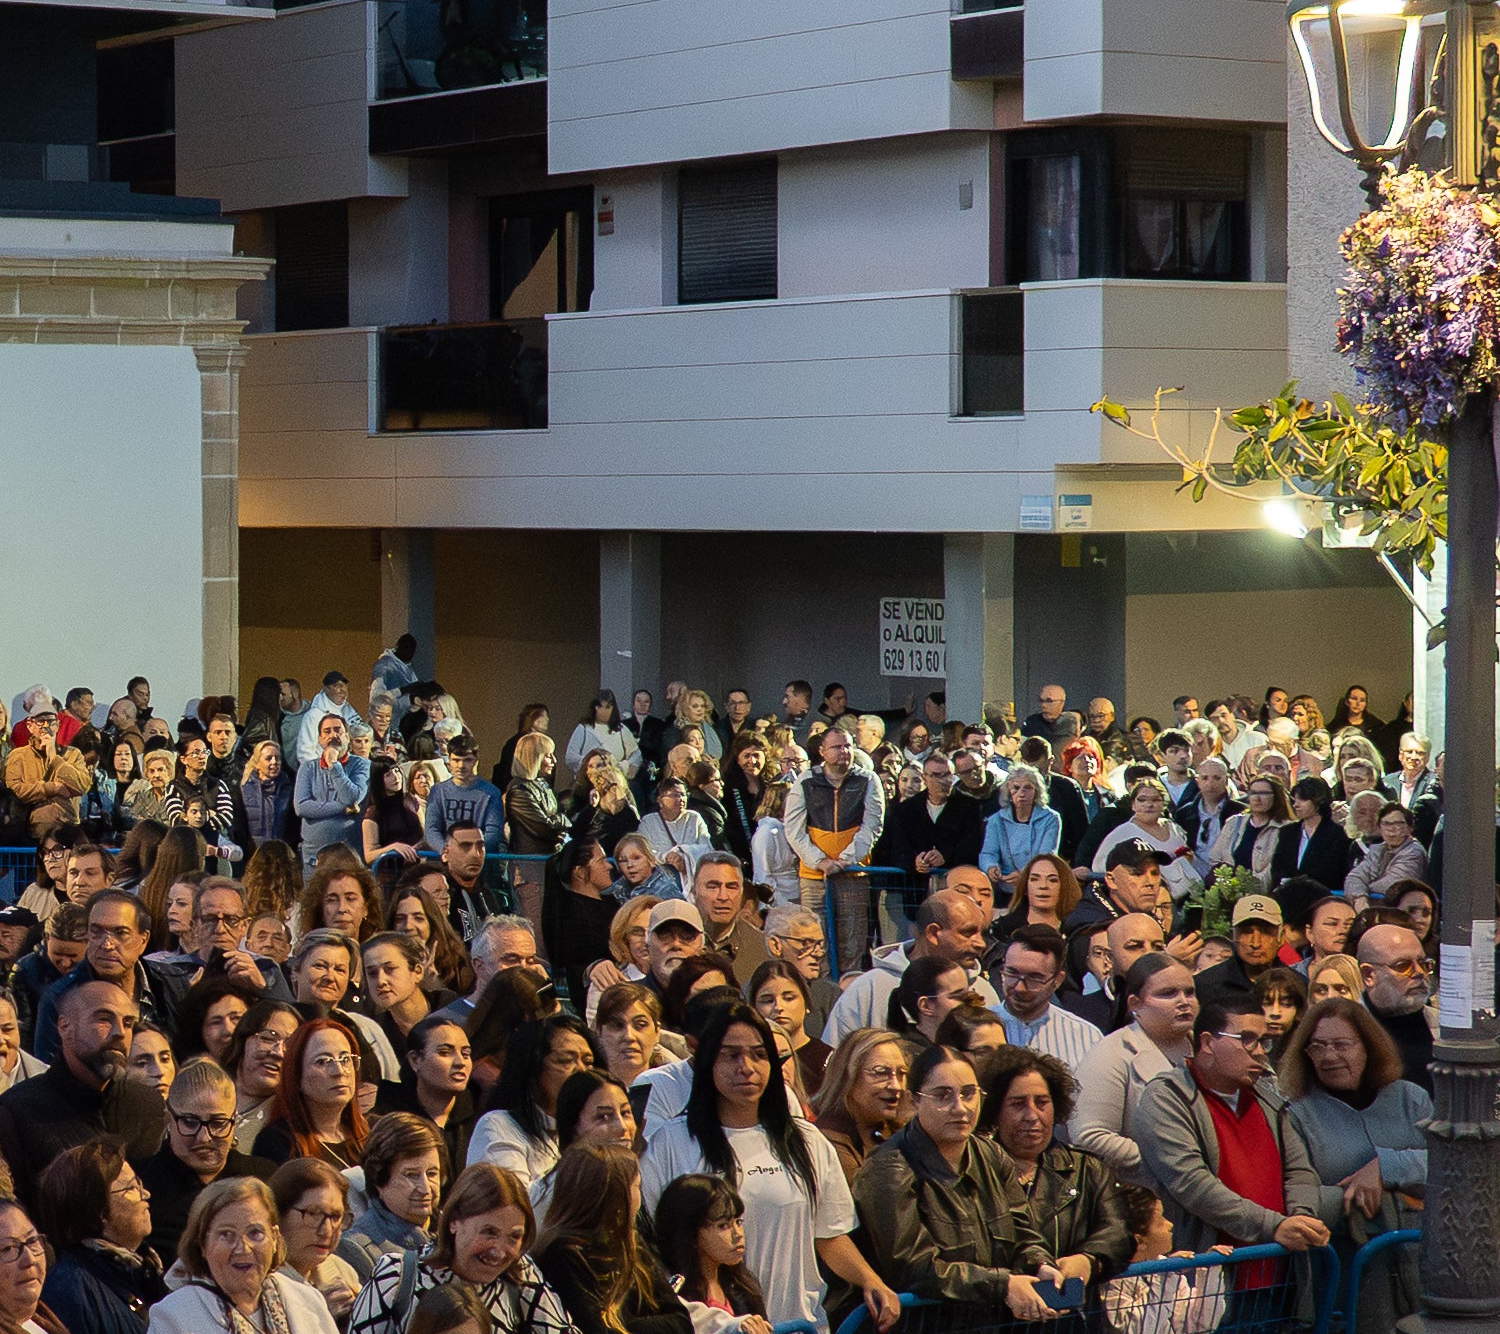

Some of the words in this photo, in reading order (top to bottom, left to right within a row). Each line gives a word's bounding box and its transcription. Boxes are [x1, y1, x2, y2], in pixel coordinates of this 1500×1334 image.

[882, 601, 901, 620] SE
[904, 601, 945, 621] VEND
[894, 624, 946, 644] ALQUIL
[884, 648, 905, 671] 629
[909, 649, 922, 671] 13
[926, 649, 940, 673] 60
[747, 1165, 783, 1176] Angel
